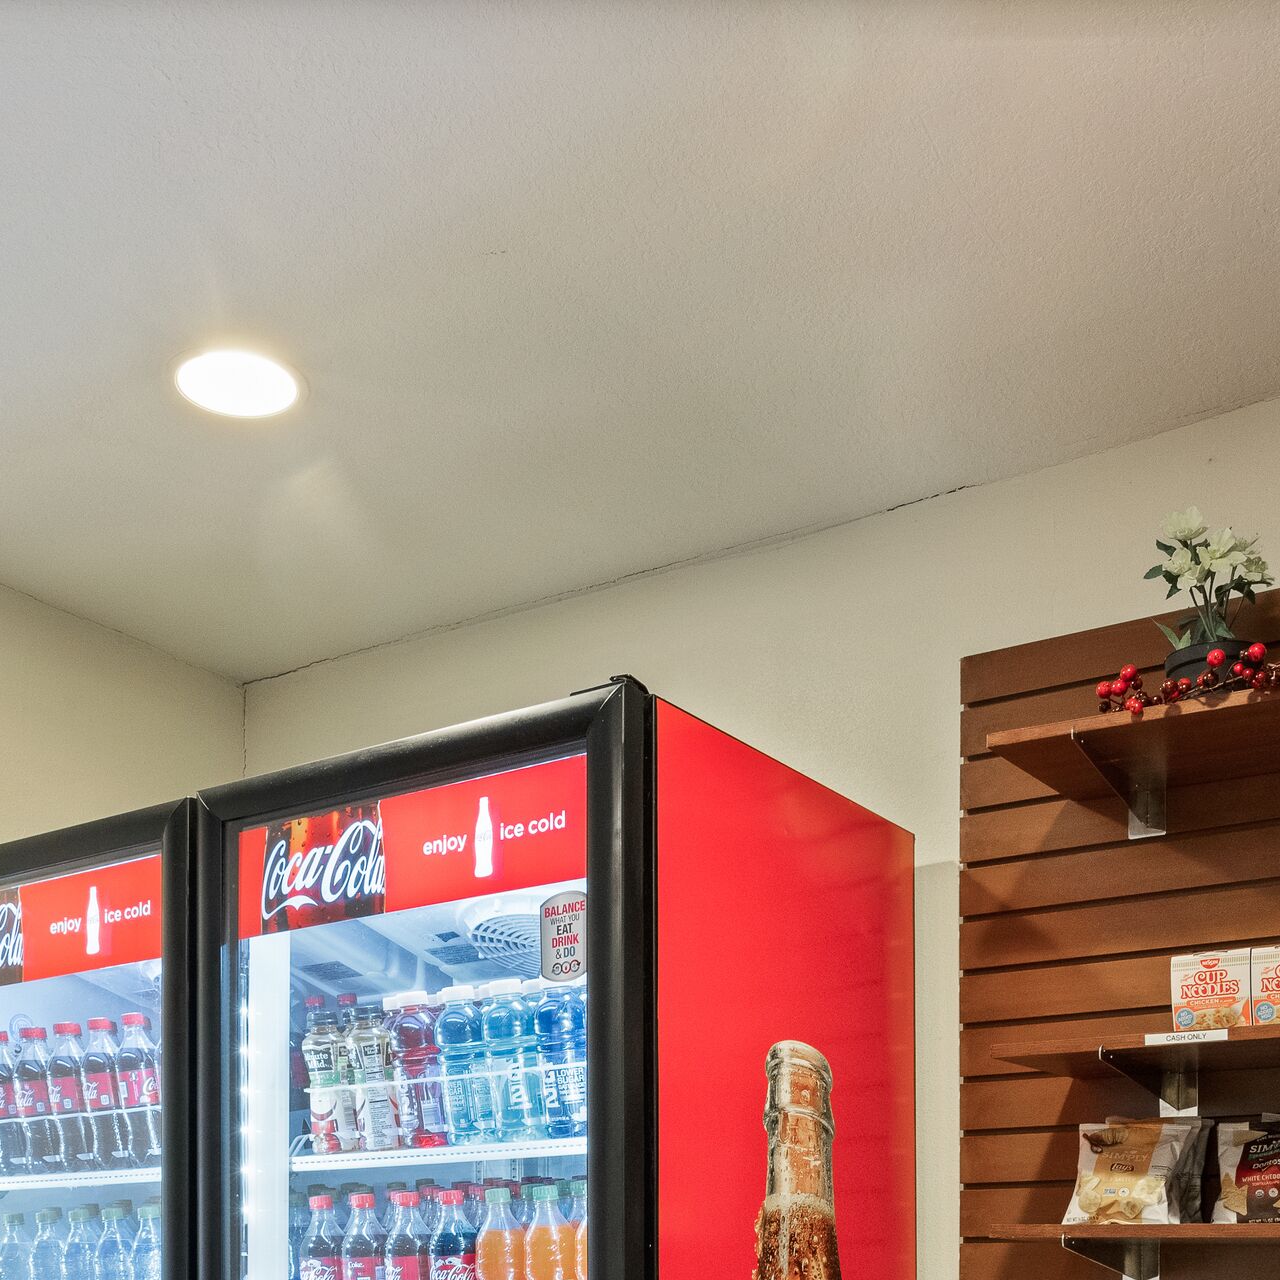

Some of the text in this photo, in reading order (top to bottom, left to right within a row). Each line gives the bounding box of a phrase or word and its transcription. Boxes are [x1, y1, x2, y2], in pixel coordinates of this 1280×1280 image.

[422, 810, 567, 856] enjoy ice cold
[261, 818, 387, 920] Coca-Cola
[49, 899, 151, 935] enjoy ice cold
[544, 900, 586, 918] BALANCE
[549, 913, 580, 926] WHAT YOU
[556, 922, 573, 936] EAT
[551, 933, 580, 949] DRINK
[563, 946, 576, 958] DO
[1193, 969, 1228, 985] CUP
[1181, 979, 1240, 999] NOODLES
[1165, 1032, 1208, 1042] CASH ONLY
[1242, 1174, 1261, 1183] WHITE
